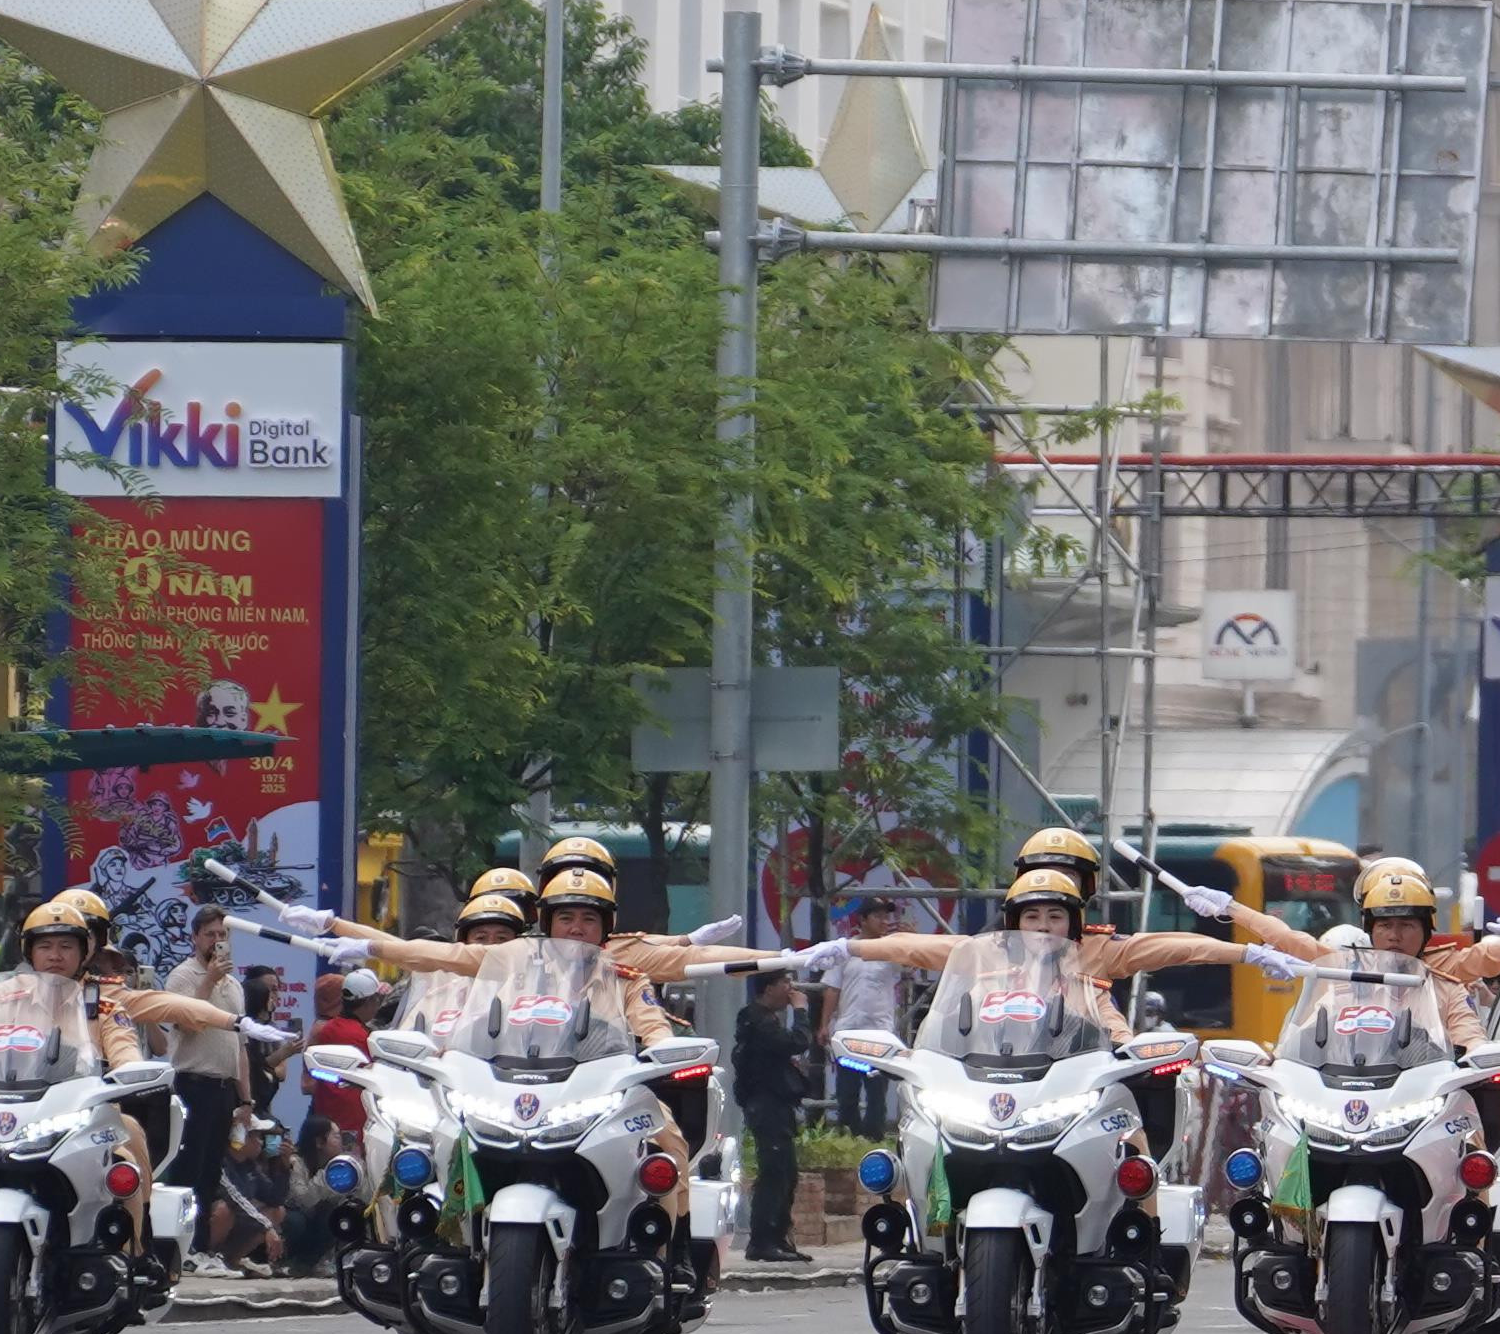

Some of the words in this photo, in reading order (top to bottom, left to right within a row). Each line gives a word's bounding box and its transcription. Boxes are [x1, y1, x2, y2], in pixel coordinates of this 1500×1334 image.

[63, 368, 242, 468] Vikki
[250, 419, 310, 440] Digital
[250, 440, 328, 465] Bank
[169, 524, 251, 552] MỪNG
[249, 755, 294, 772] 30/4
[261, 773, 286, 783] 1975
[623, 1113, 656, 1133] CSGT
[1100, 1113, 1131, 1133] CSGT
[1444, 1116, 1472, 1135] CSGT
